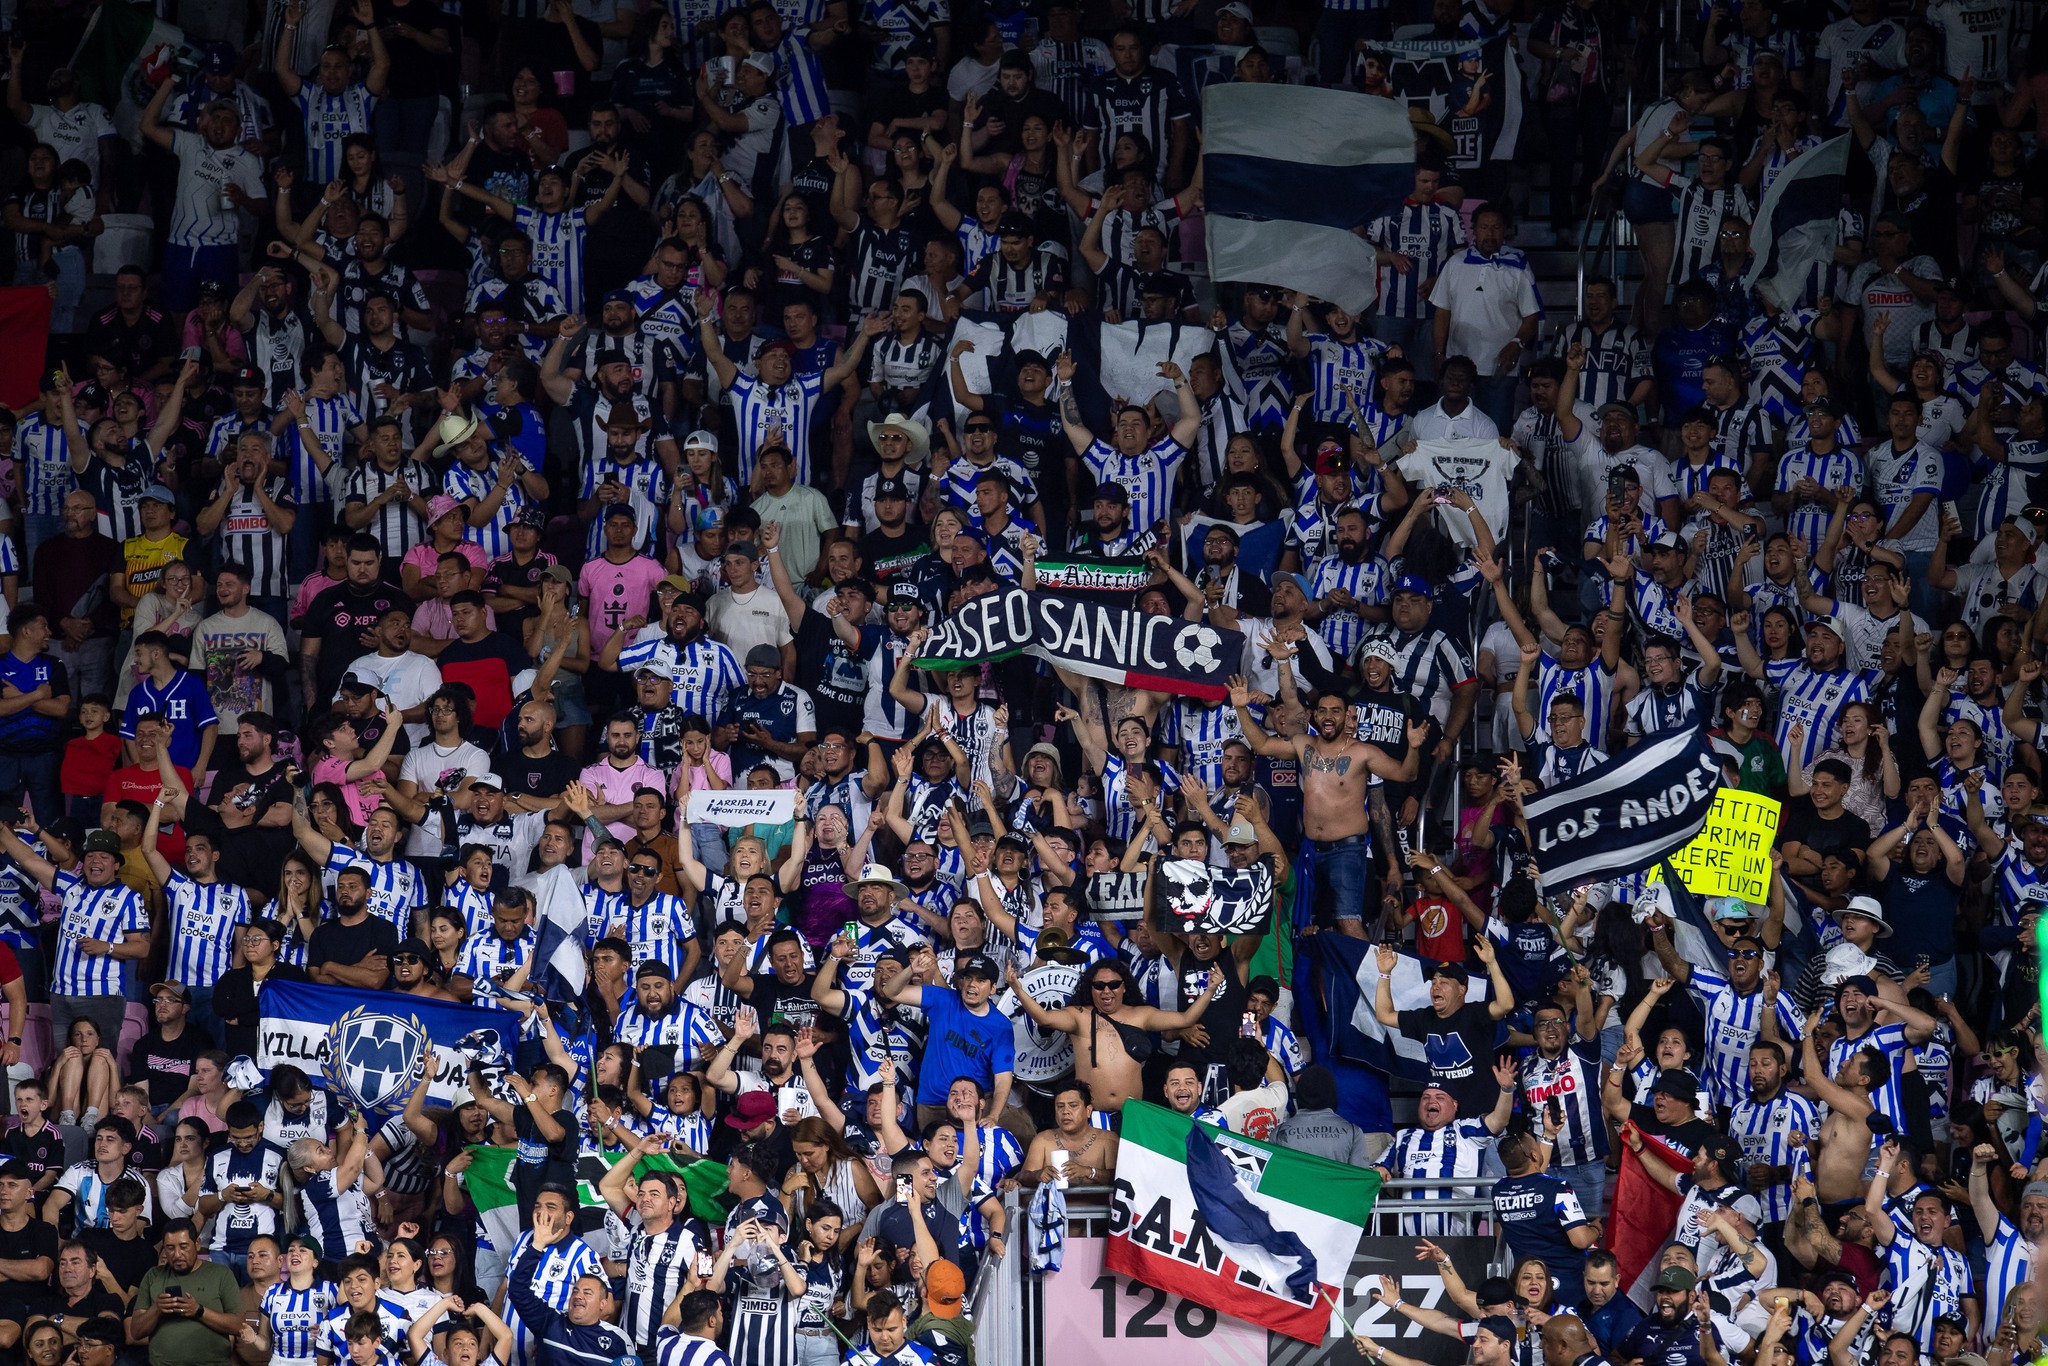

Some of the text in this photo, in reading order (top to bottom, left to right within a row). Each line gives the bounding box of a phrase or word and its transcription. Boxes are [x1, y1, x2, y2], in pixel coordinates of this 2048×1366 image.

[1960, 9, 2003, 24] TECATE
[1114, 99, 1140, 107] BBVA
[1114, 114, 1143, 125] codere
[1693, 205, 1718, 216] BBVA
[1402, 236, 1427, 244] BBVA
[1689, 238, 1709, 247] AT&T
[536, 243, 560, 252] BBVA
[876, 250, 898, 262] BBVA
[533, 258, 566, 270] codere
[868, 268, 898, 281] codere
[644, 323, 681, 336] codere
[1754, 341, 1778, 353] BBVA
[272, 359, 294, 372] AT&T
[1339, 368, 1366, 378] BBVA
[1020, 436, 1045, 447] BBVA
[1878, 494, 1911, 504] codere
[1795, 504, 1828, 515] codere
[226, 517, 269, 531] BIMBO
[920, 589, 1032, 658] PASEO
[1647, 623, 1682, 638] codere
[203, 632, 267, 651] MESSI
[35, 667, 48, 681] H
[816, 685, 854, 703] SAME OLD
[170, 699, 188, 719] H
[1788, 696, 1814, 711] BBVA
[757, 799, 769, 807] EL
[1540, 808, 1601, 852] LOS
[807, 862, 841, 875] BBVA
[1743, 848, 1766, 876] UN
[803, 872, 847, 888] codere
[1714, 871, 1763, 897] TUYO
[69, 913, 91, 927] BBVA
[187, 911, 213, 925] BBVA
[179, 926, 216, 943] codere
[1080, 928, 1101, 938] odere
[1722, 1025, 1749, 1039] BBVA
[264, 1032, 332, 1063] VILLA
[280, 1129, 311, 1139] BBVA
[1289, 1124, 1349, 1137] GUARDIAN
[1743, 1136, 1767, 1147] BBVA
[1494, 1194, 1536, 1211] TECATE
[230, 1218, 255, 1230] AT&T
[1680, 1233, 1698, 1245] AT&T
[741, 1299, 778, 1312] BIMBO
[280, 1311, 312, 1321] BBVA
